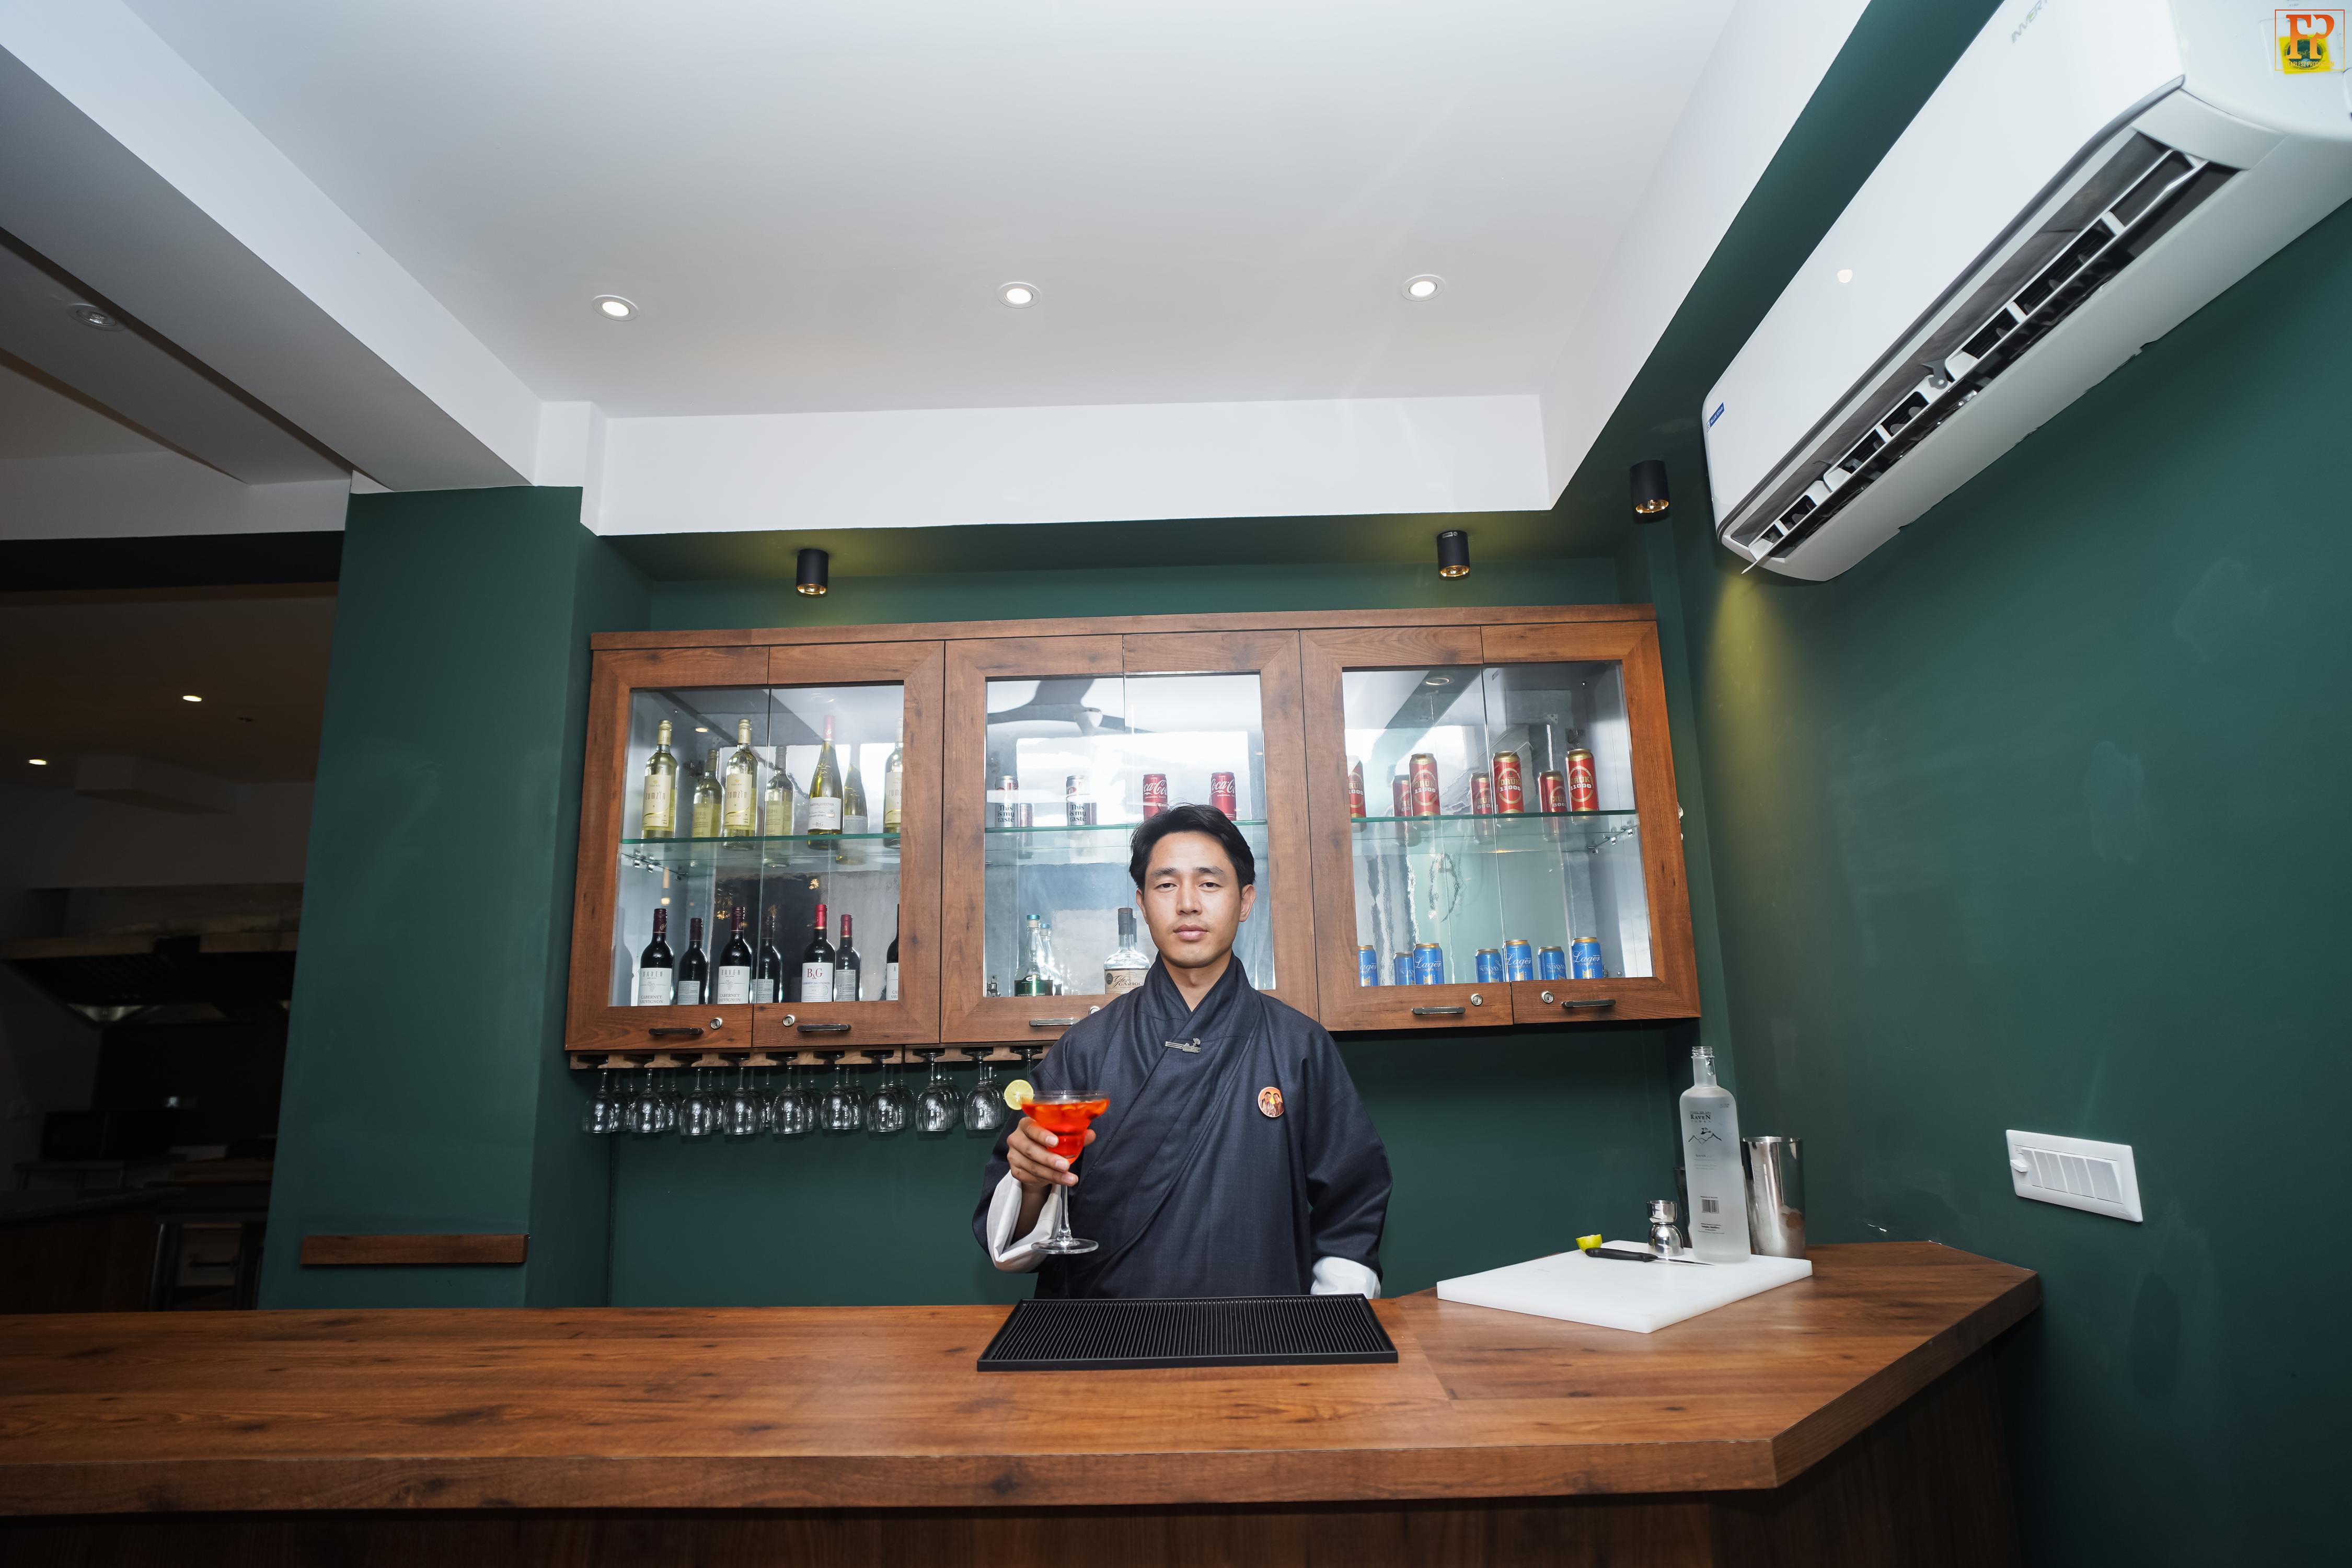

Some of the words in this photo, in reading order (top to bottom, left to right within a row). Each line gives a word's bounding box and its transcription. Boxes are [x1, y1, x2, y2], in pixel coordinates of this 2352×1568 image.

[2011, 0, 2047, 43] INVER
[1500, 778, 1520, 786] DRUK
[1414, 956, 1442, 973] Lager
[1507, 953, 1531, 969] Lager
[1573, 950, 1600, 966] Lager
[806, 968, 823, 979] B&G
[1360, 964, 1377, 975] ager
[1112, 975, 1132, 989] Glen
